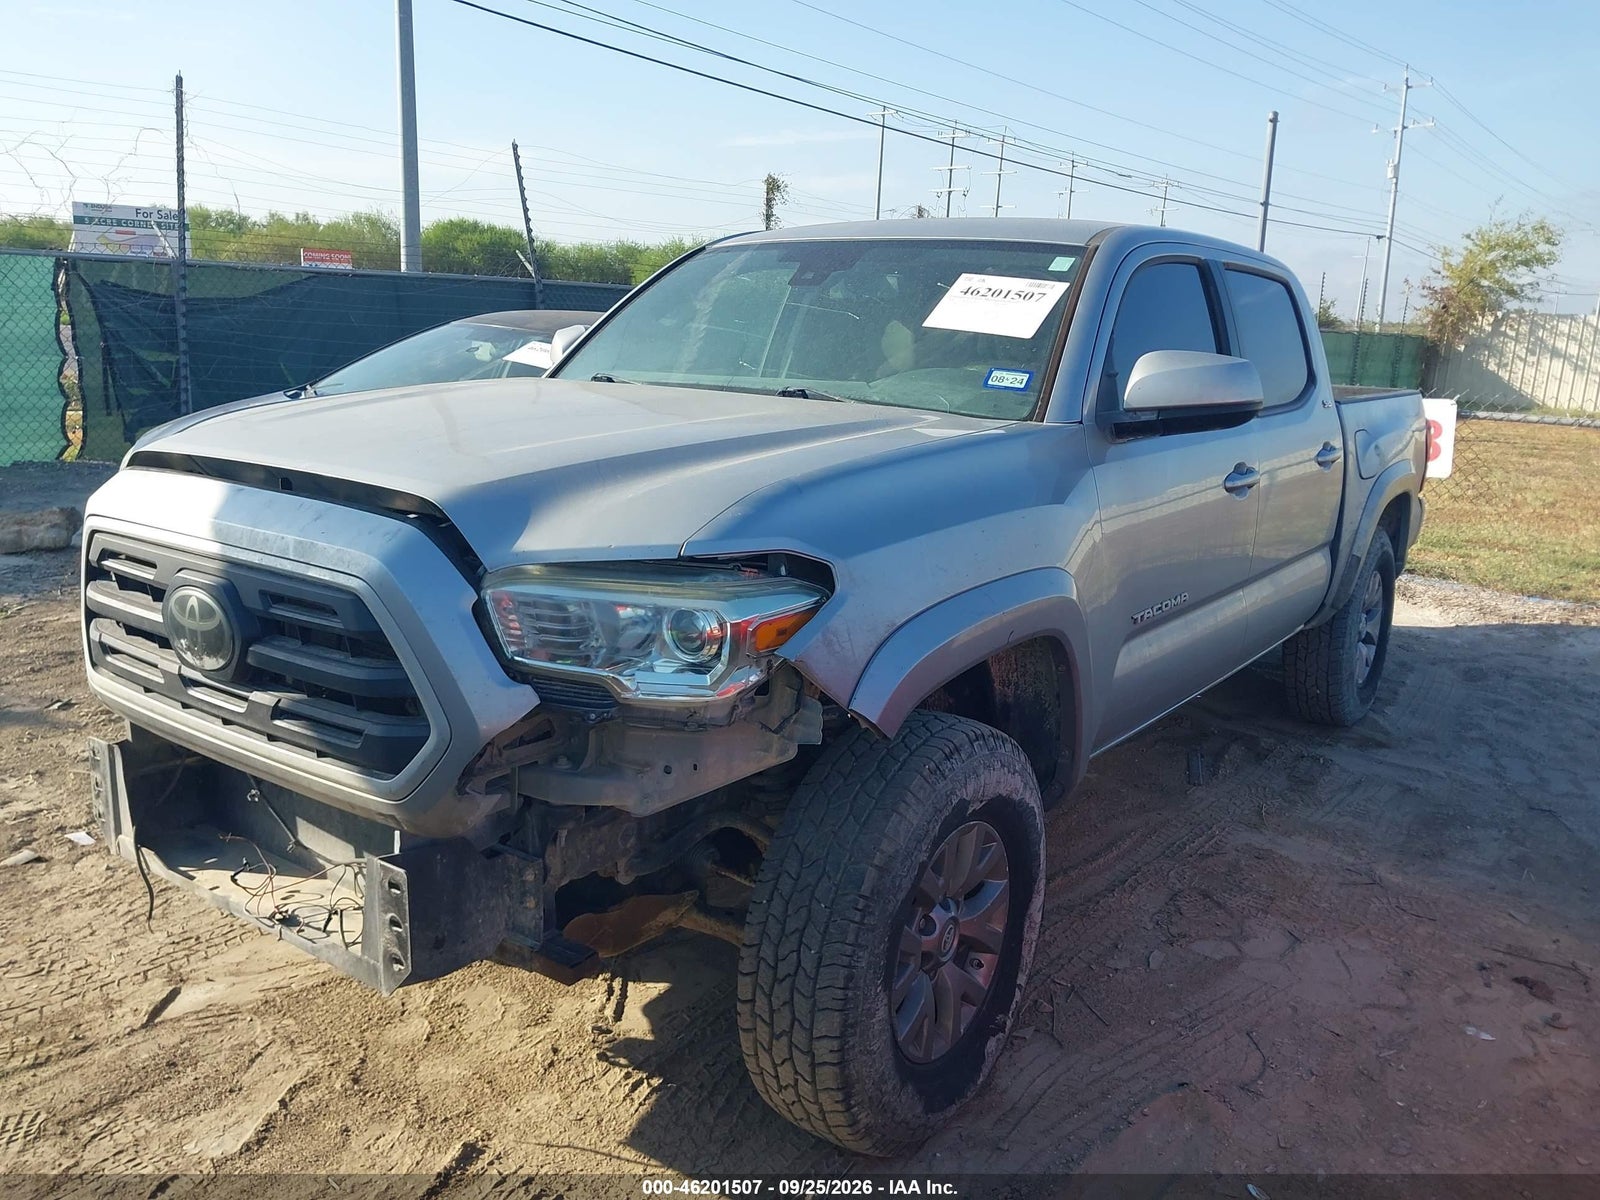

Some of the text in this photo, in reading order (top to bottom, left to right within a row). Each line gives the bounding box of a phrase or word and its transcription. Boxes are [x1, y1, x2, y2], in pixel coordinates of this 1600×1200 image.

[135, 208, 179, 221] For Sale
[960, 285, 1047, 302] 46201507
[1131, 592, 1189, 623] TACOMA
